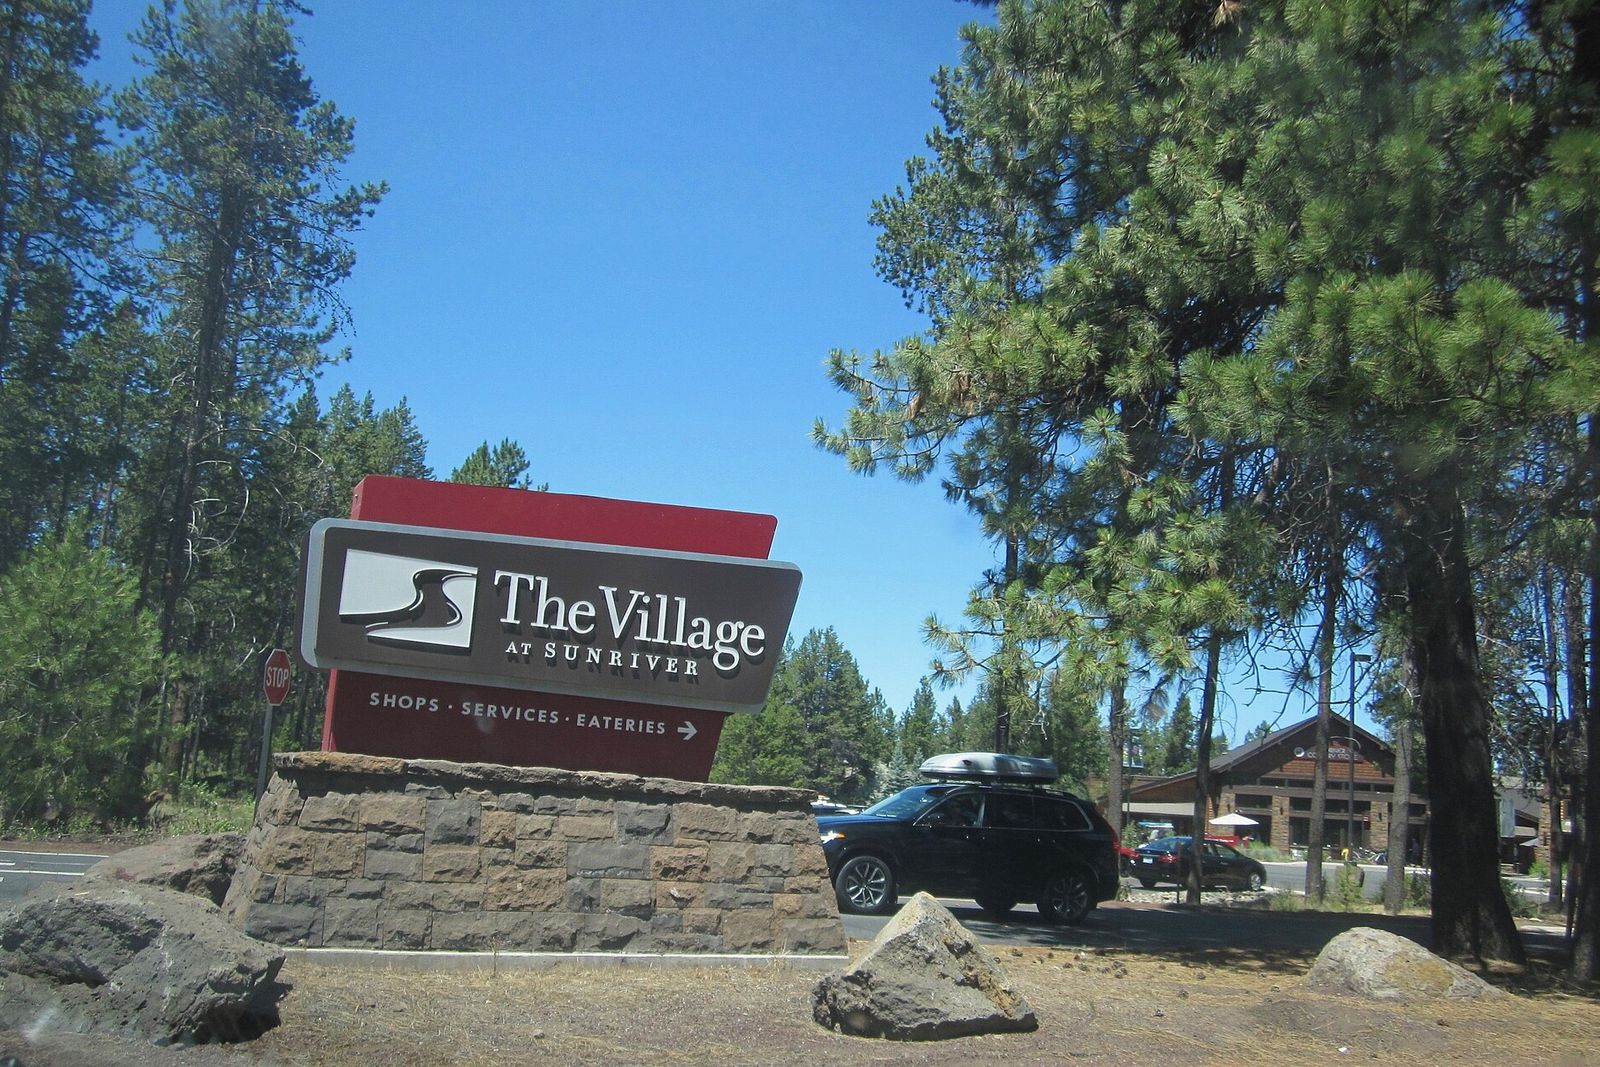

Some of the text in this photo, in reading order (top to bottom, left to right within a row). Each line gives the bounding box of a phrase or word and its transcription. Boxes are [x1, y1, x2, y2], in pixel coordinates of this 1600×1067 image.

[494, 569, 765, 671] The Village
[266, 666, 289, 688] STOP
[505, 641, 698, 676] AT SUNRIVER
[369, 692, 666, 735] SHOPS SERVICES EATERIES
